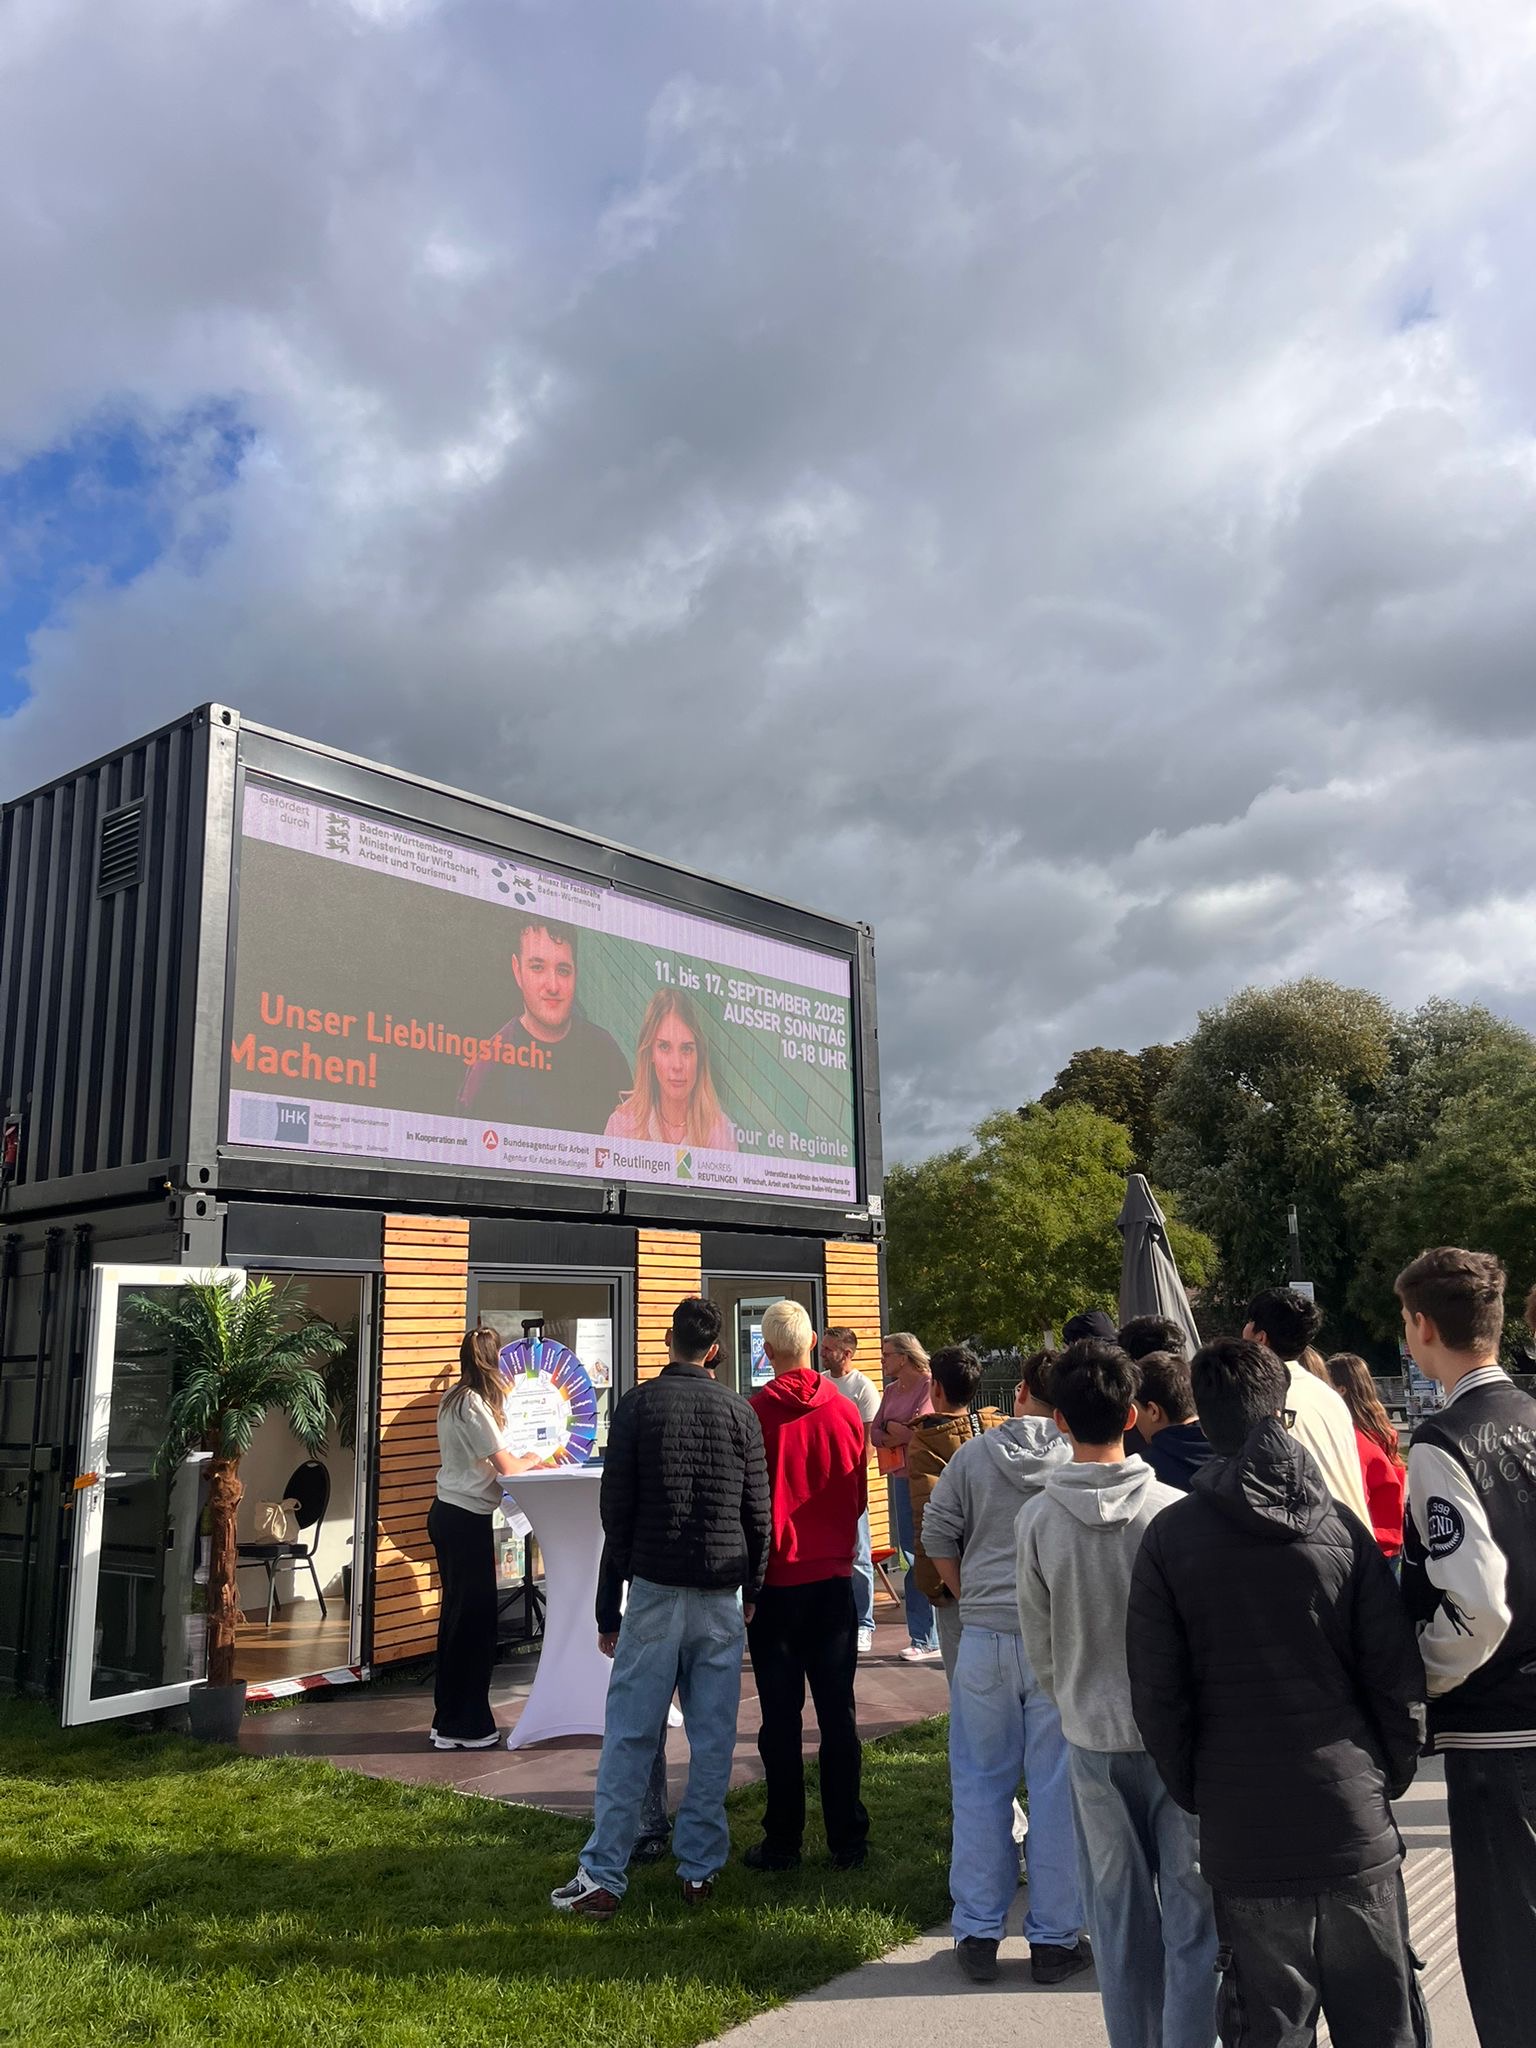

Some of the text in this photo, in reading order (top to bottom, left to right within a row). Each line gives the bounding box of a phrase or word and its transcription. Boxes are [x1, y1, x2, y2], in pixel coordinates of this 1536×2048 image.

[260, 792, 309, 816] Gefördert
[280, 813, 310, 830] durch
[359, 822, 453, 858] Baden-Württemberg
[358, 848, 456, 883] Arbeit und Tourismus
[359, 835, 480, 879] Ministerium für Wirtschaft,
[655, 960, 845, 1026] 11. bis 17. SEPTEMBER 2025
[260, 991, 552, 1071] Unser Lieblingsfach:
[723, 1002, 846, 1047] AUSSER SONNTAG
[231, 1033, 377, 1088] Machen!
[781, 1038, 847, 1070] 10-18 UHR
[280, 1108, 307, 1125] IHK
[414, 1133, 456, 1146] Kooperation
[456, 1136, 468, 1146] mit
[503, 1137, 590, 1155] Bundesagentur für Arbeit
[728, 1123, 762, 1146] Tour
[767, 1129, 785, 1150] de
[503, 1152, 588, 1169] Agentur für Arbeit Reutlingen
[613, 1152, 671, 1174] Reutlingen
[697, 1159, 732, 1173] LANDKREIS
[697, 1172, 738, 1185] REUTLINGEN
[1430, 1502, 1450, 1515] 998
